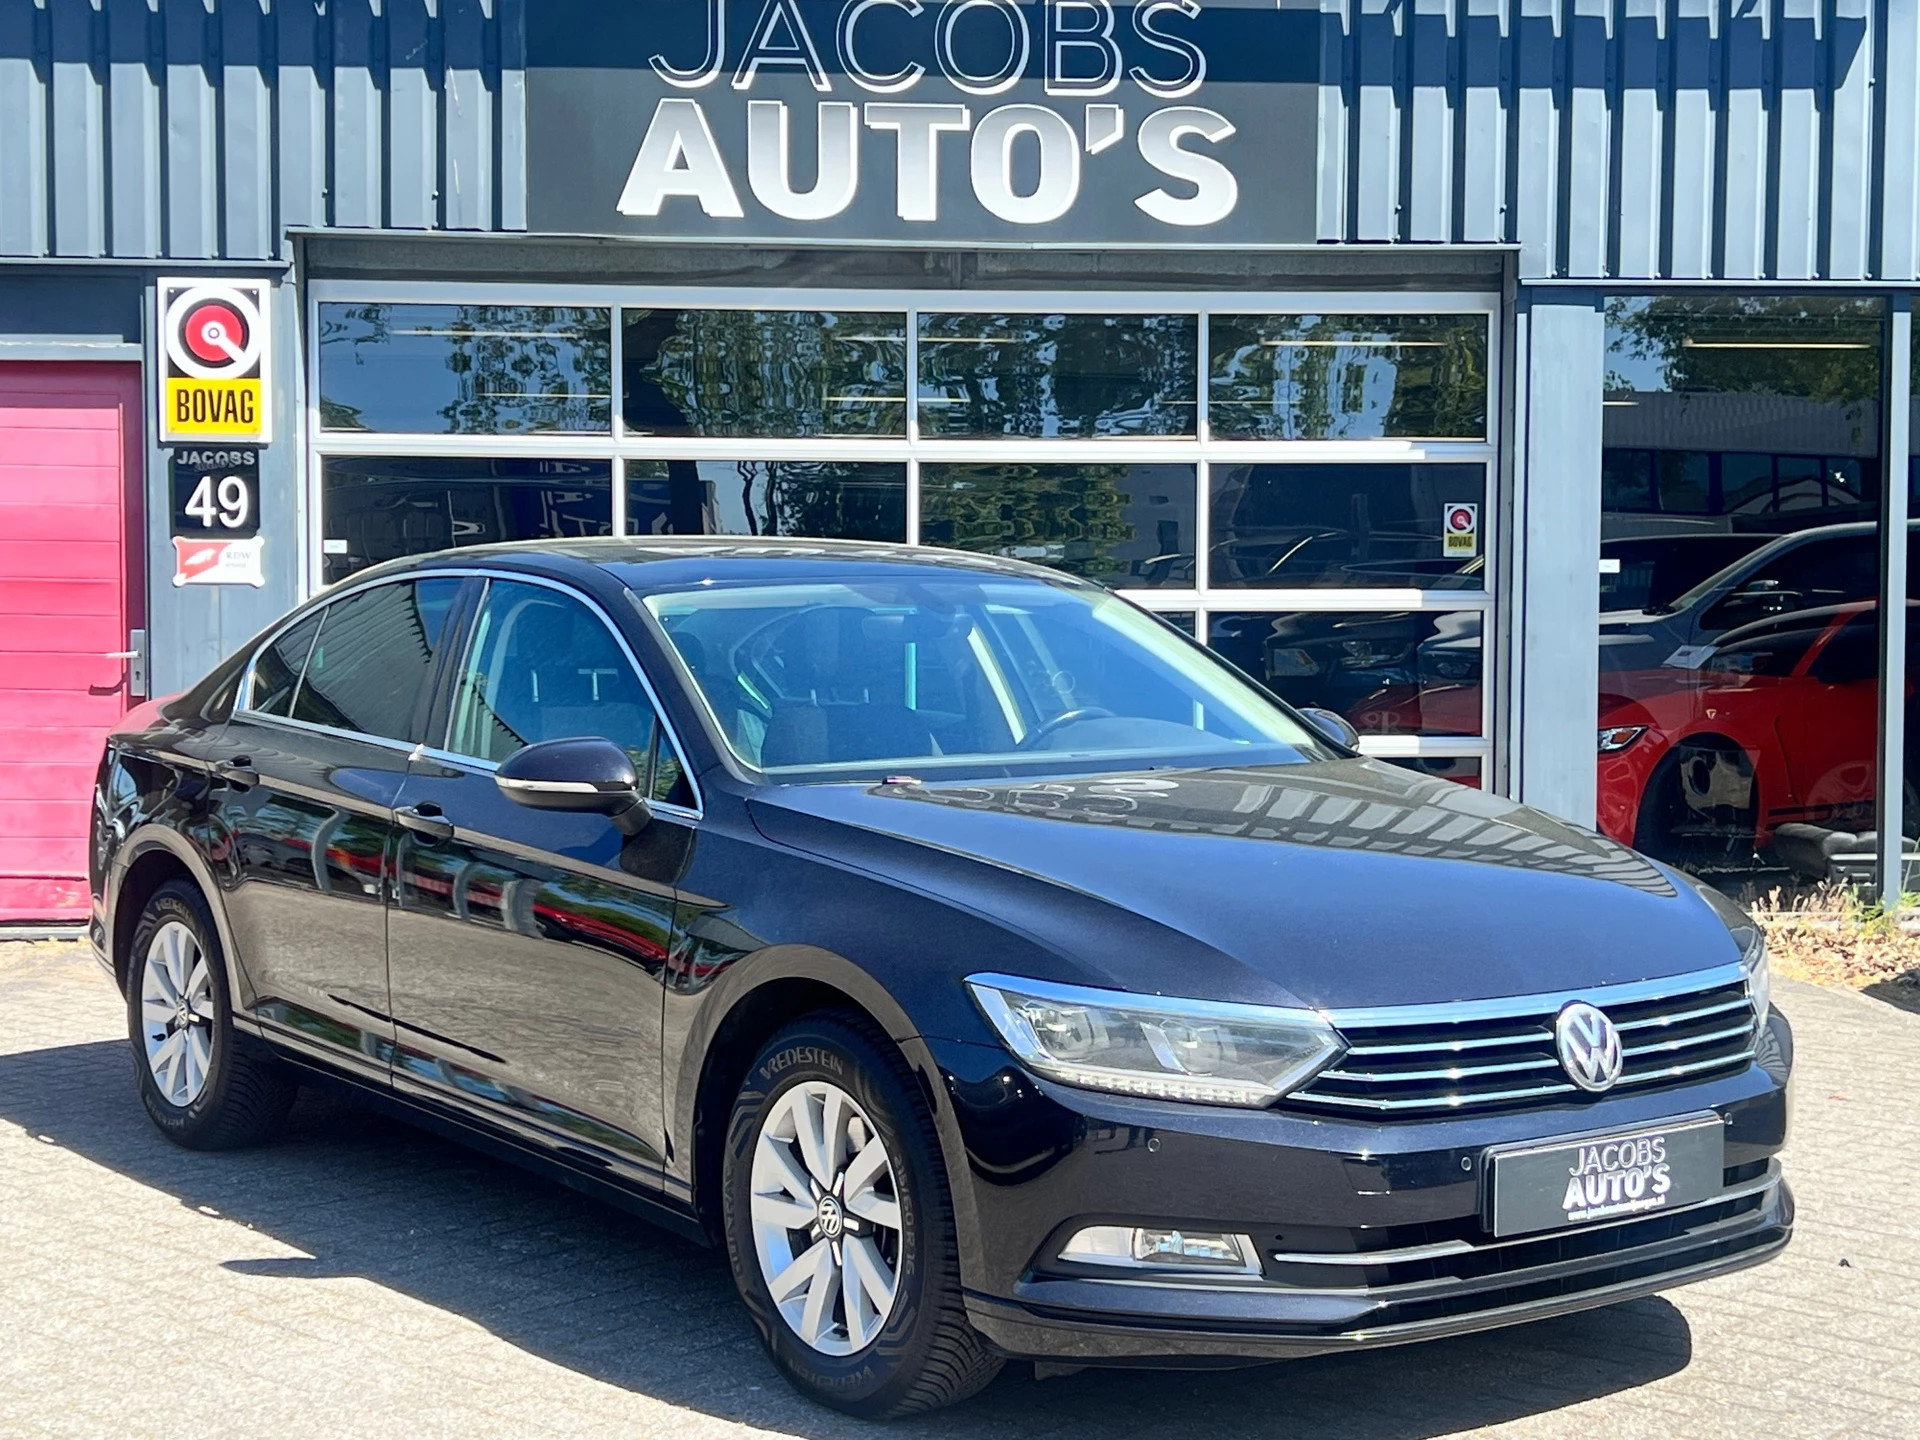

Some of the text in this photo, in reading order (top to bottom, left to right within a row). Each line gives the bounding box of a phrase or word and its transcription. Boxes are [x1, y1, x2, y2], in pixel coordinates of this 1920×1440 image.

[649, 0, 1208, 98] JACOBS
[615, 98, 1239, 226] AUTO'S
[176, 388, 254, 424] BOVAG
[176, 450, 256, 466] JACOBS
[185, 475, 249, 529] 49
[1448, 536, 1472, 547] BOVAG
[758, 1046, 844, 1080] VREDESTEIN
[1568, 1136, 1667, 1177] JACOBS
[1562, 1163, 1673, 1212] AUTO'S
